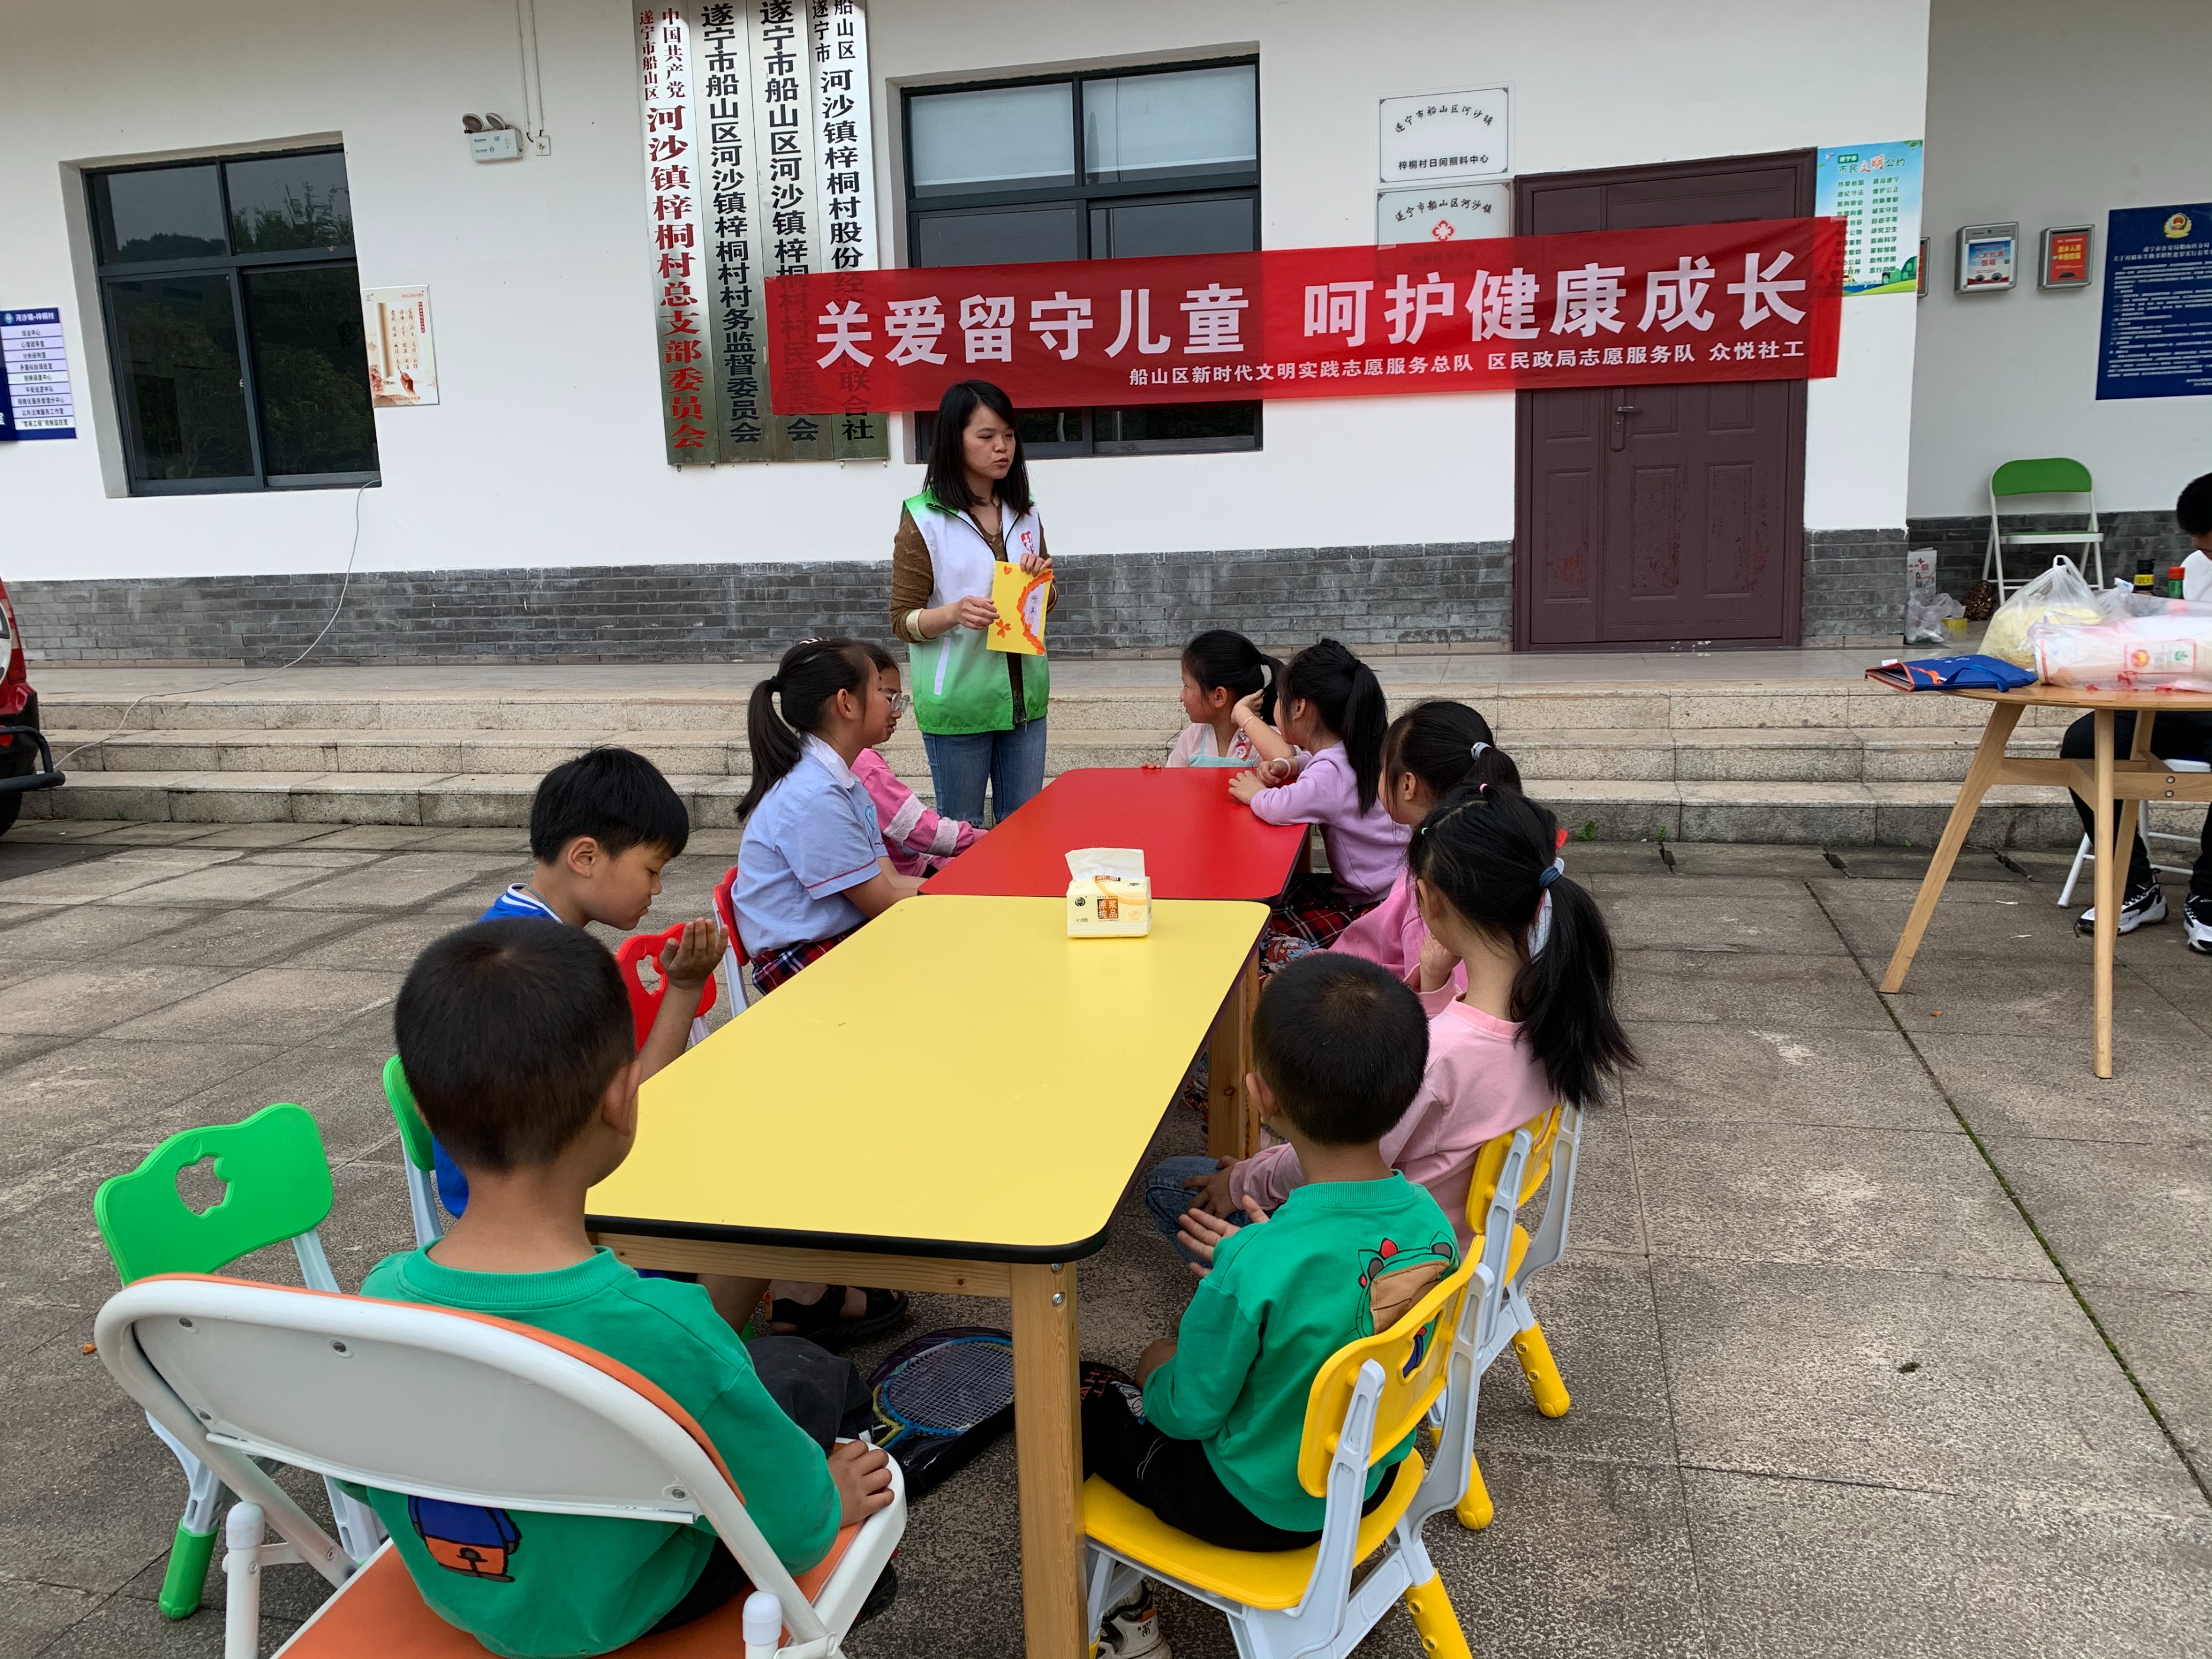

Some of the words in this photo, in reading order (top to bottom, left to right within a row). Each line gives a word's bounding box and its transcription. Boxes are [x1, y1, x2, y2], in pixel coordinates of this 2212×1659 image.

[640, 9, 659, 101] 遂宁市船山区
[663, 8, 686, 98] 中国共产党
[1399, 154, 1489, 170] 梓桐村日间照料中心
[701, 2, 761, 443] 遂宁市船山区河沙镇梓桐村村务监督委员会
[647, 105, 708, 448] 河沙镇梓桐村总支部委员会
[816, 283, 1249, 369] 关爱留守儿童
[1303, 250, 1808, 347] 呵护健康成长
[1129, 354, 1474, 386] 船山区新时代文明实践志愿服务总队
[1488, 343, 1696, 370] 区民政局志愿服务队
[1709, 340, 1805, 362] 众悦社工
